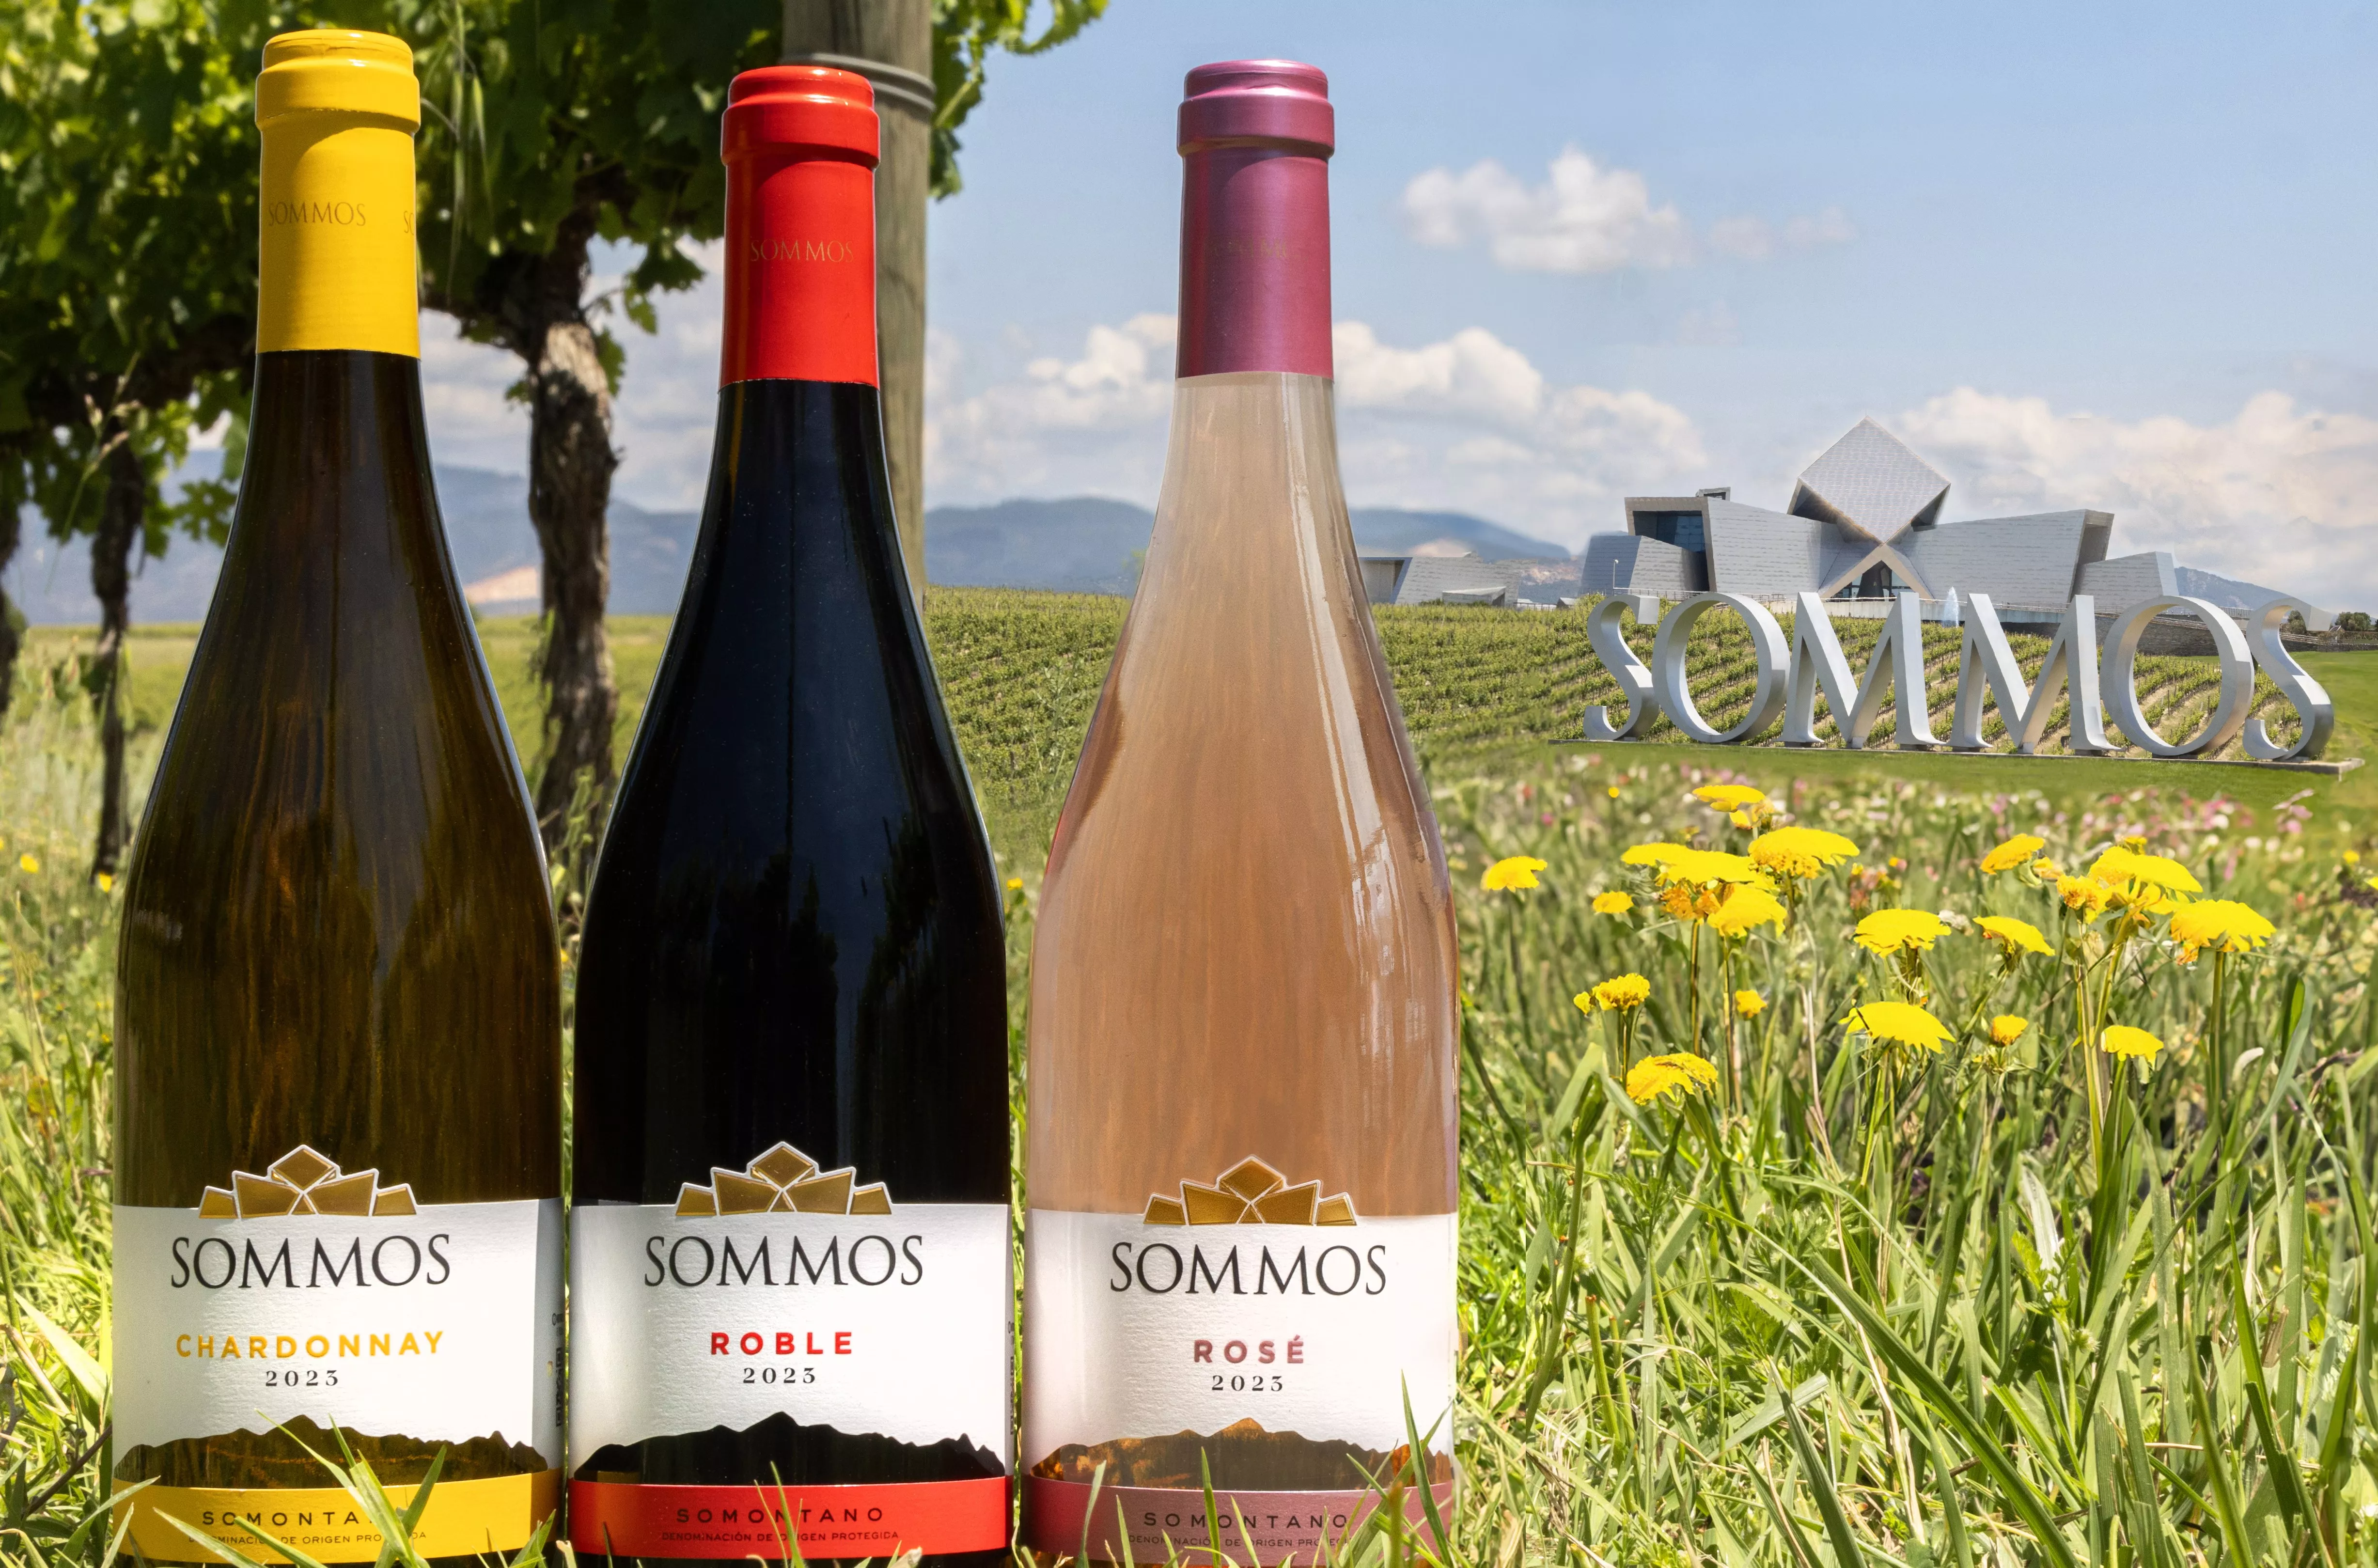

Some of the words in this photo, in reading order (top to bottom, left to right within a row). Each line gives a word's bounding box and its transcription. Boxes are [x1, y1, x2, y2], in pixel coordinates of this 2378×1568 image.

[268, 201, 367, 227] SOMMOS
[750, 239, 854, 263] SOMMOS
[1582, 591, 2335, 762] SOMMOS
[171, 1234, 450, 1289] SOMMOS
[644, 1235, 923, 1287] SOMMOS
[1111, 1242, 1386, 1296] SOMMOS
[176, 1331, 443, 1358] CHARDONNAY
[711, 1332, 852, 1355] ROBLE
[1194, 1335, 1304, 1364] ROSÉ
[265, 1370, 339, 1387] 2023
[743, 1367, 815, 1384] 2023
[1212, 1375, 1283, 1392] 2023
[1144, 1512, 1347, 1529] SOMONTANO
[302, 1536, 350, 1544] ORIGEN
[662, 1532, 751, 1542] DENOMINACIÓN
[757, 1533, 773, 1541] DE
[831, 1531, 899, 1541] PROTEGIDA
[1225, 1538, 1241, 1547] DE
